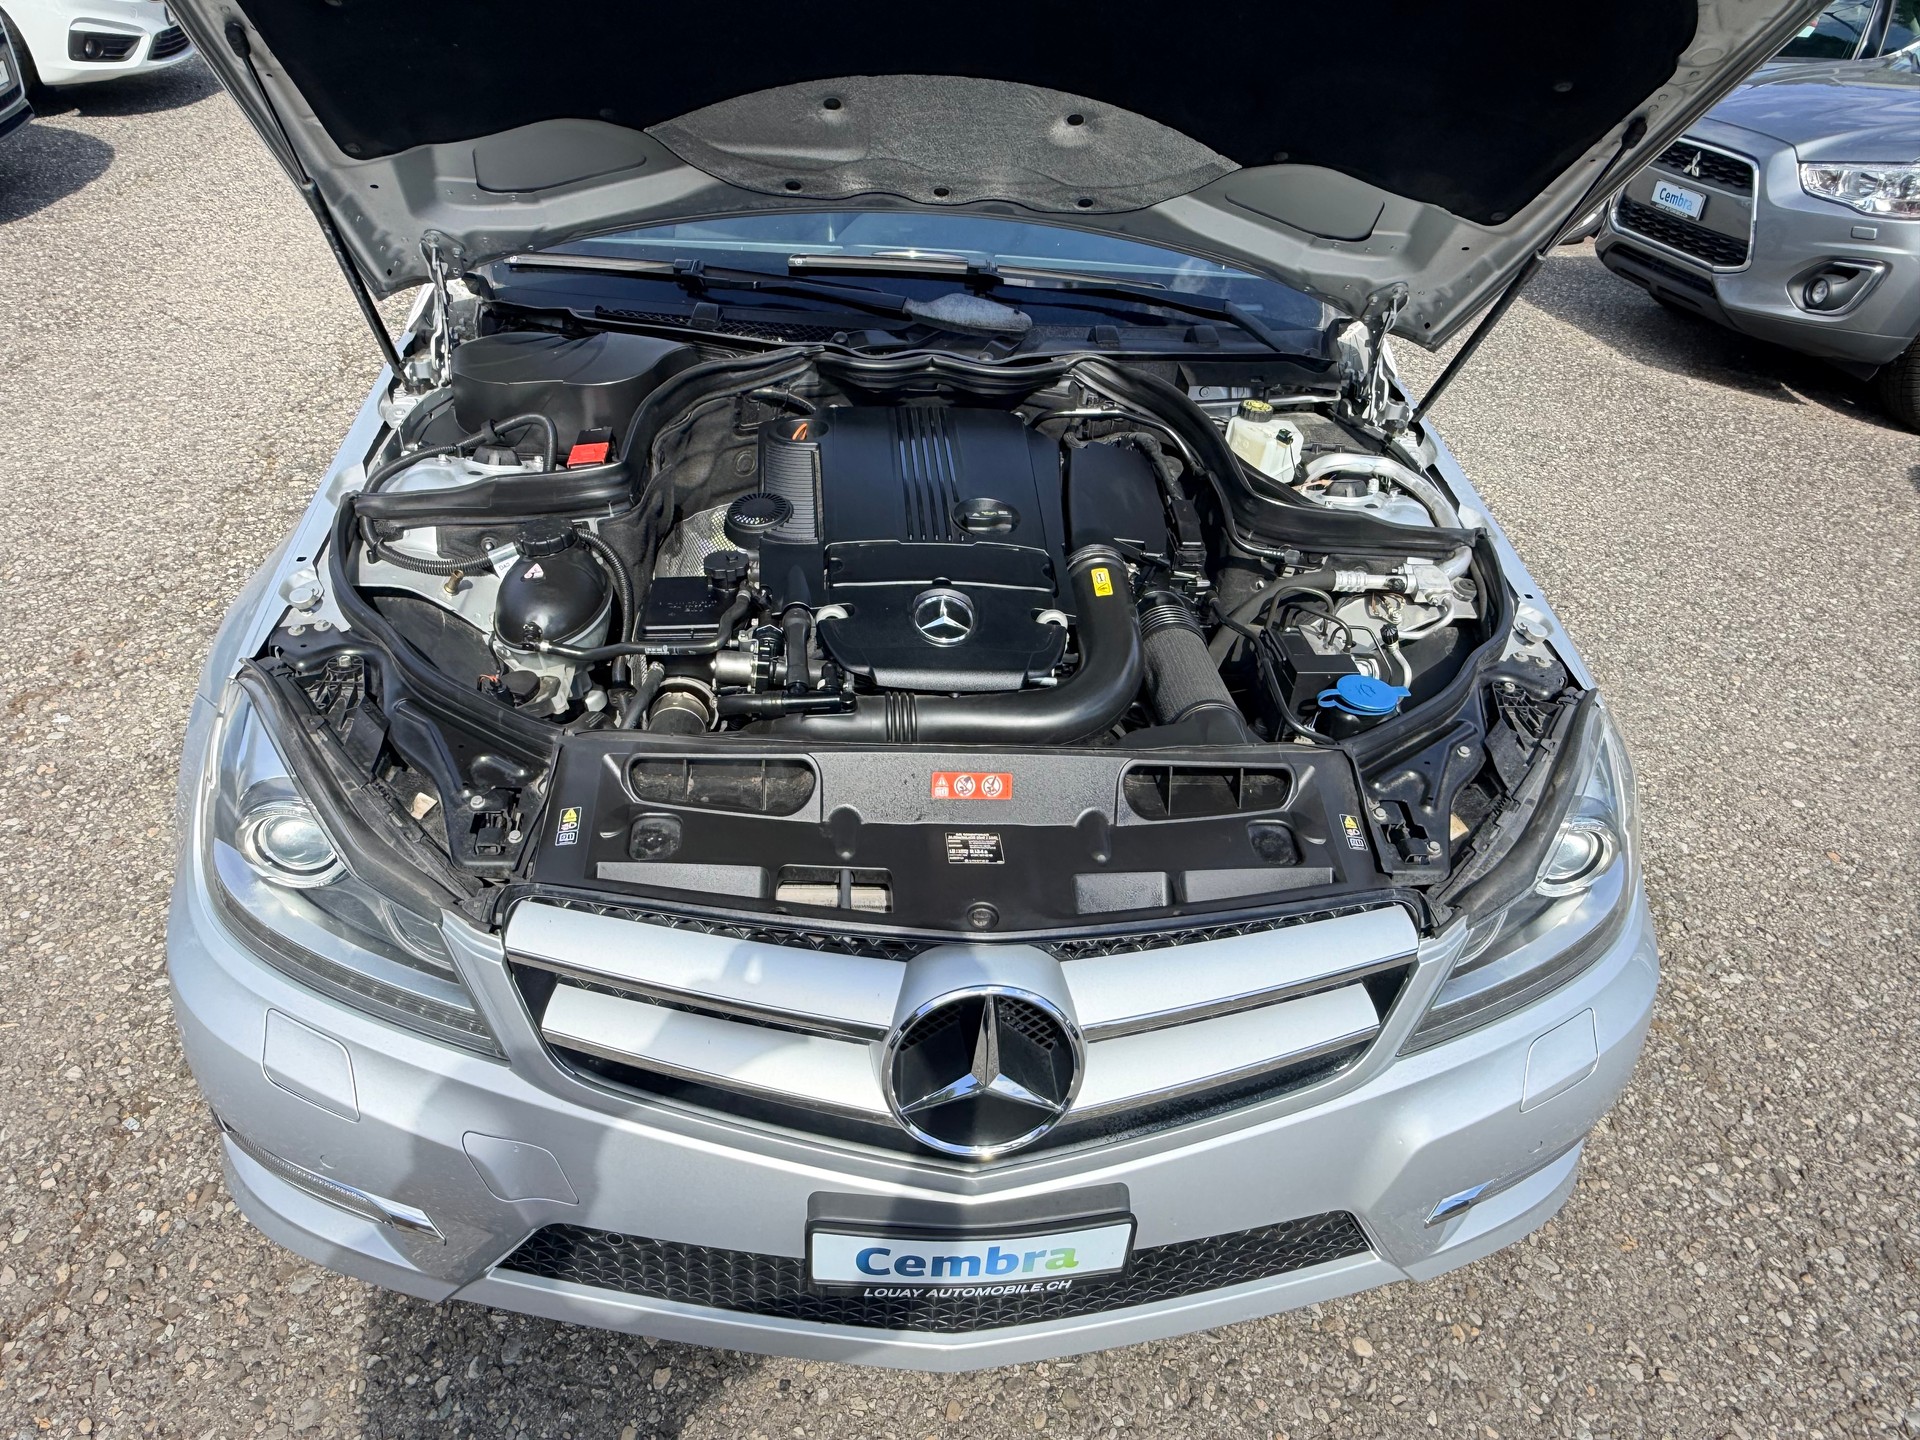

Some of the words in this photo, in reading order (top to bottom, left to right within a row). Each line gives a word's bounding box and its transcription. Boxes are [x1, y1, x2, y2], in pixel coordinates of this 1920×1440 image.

[1659, 187, 1692, 211] Cembra
[855, 1246, 1080, 1277] Cembra
[863, 1287, 921, 1298] LOUAY
[926, 1280, 1072, 1298] AUTOMOBILE.CH
